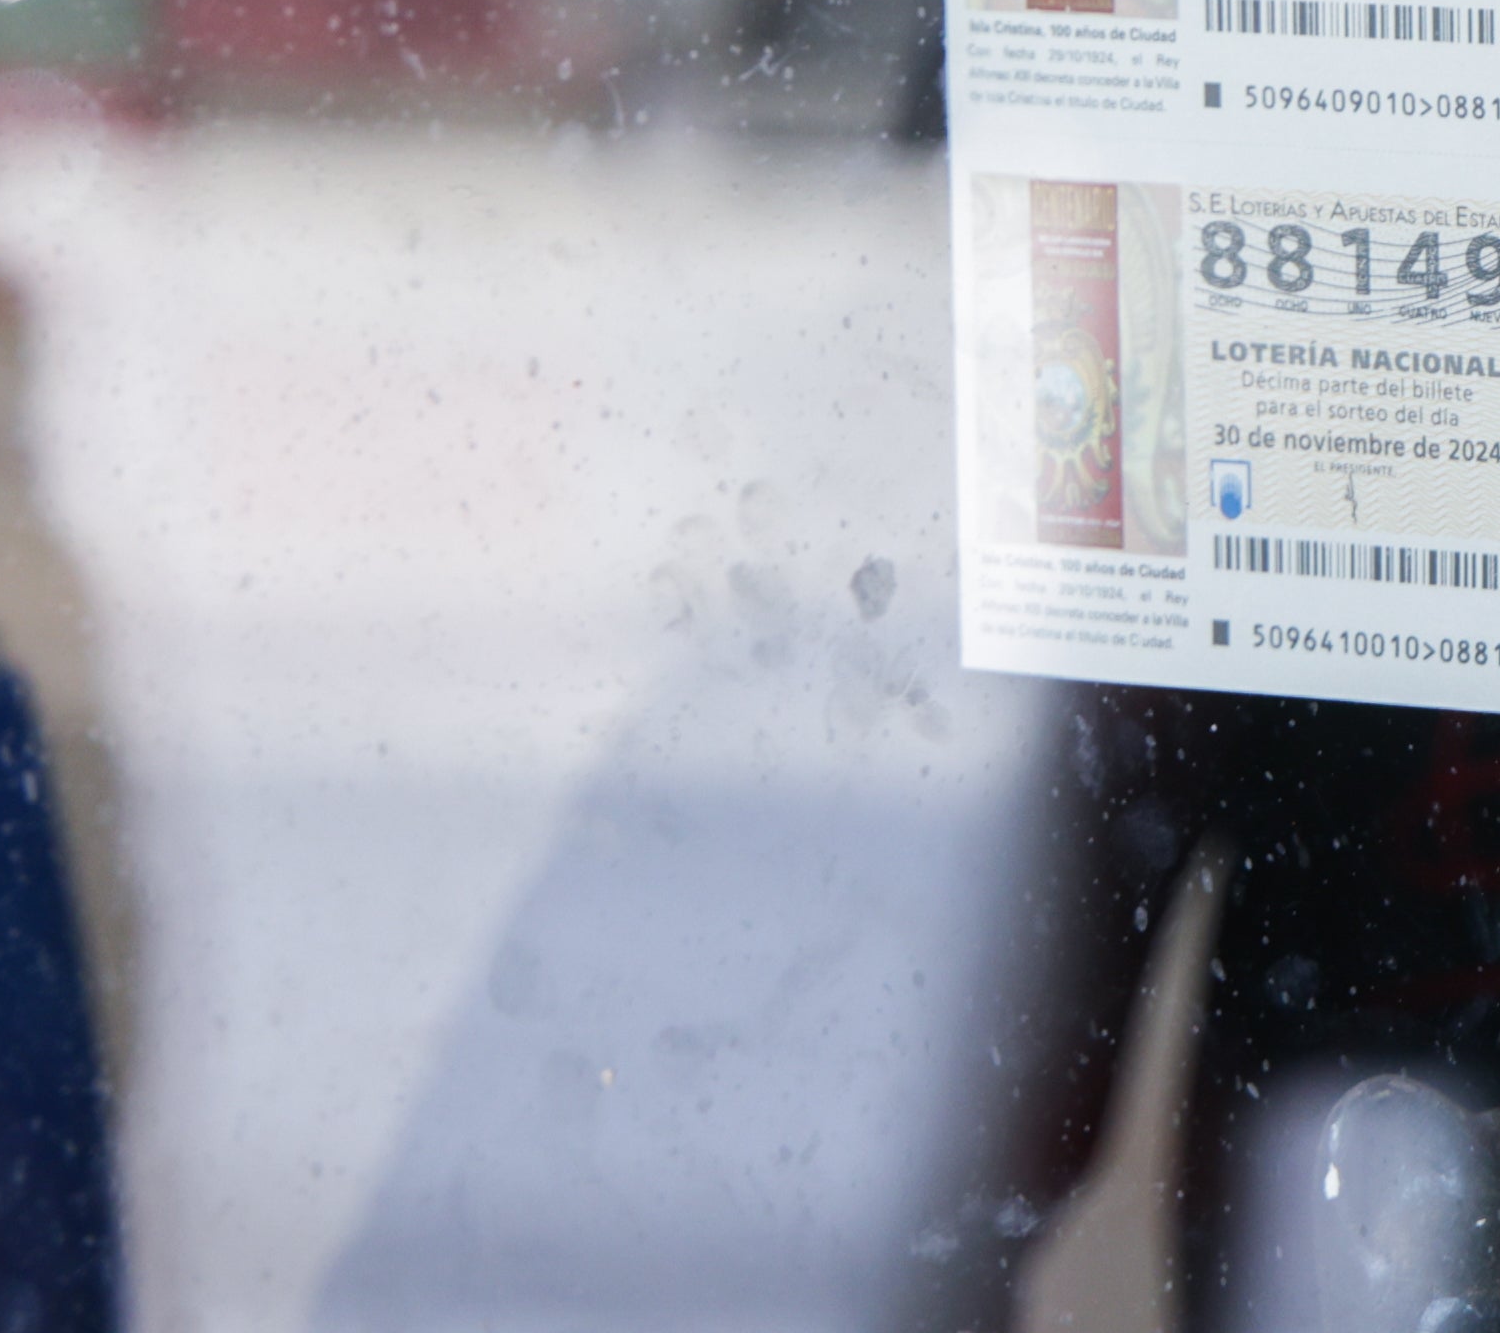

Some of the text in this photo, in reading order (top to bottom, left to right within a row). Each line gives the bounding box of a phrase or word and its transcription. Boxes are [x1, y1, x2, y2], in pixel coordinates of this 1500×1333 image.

[1211, 341, 1338, 367] LOTERÍA
[1241, 370, 1474, 402] Décima parte del billete
[1255, 399, 1459, 427] para el sorteo del día
[1214, 423, 1240, 446] 30
[1247, 426, 1276, 448] de
[1284, 431, 1405, 457] noviembre
[1412, 435, 1440, 459] de
